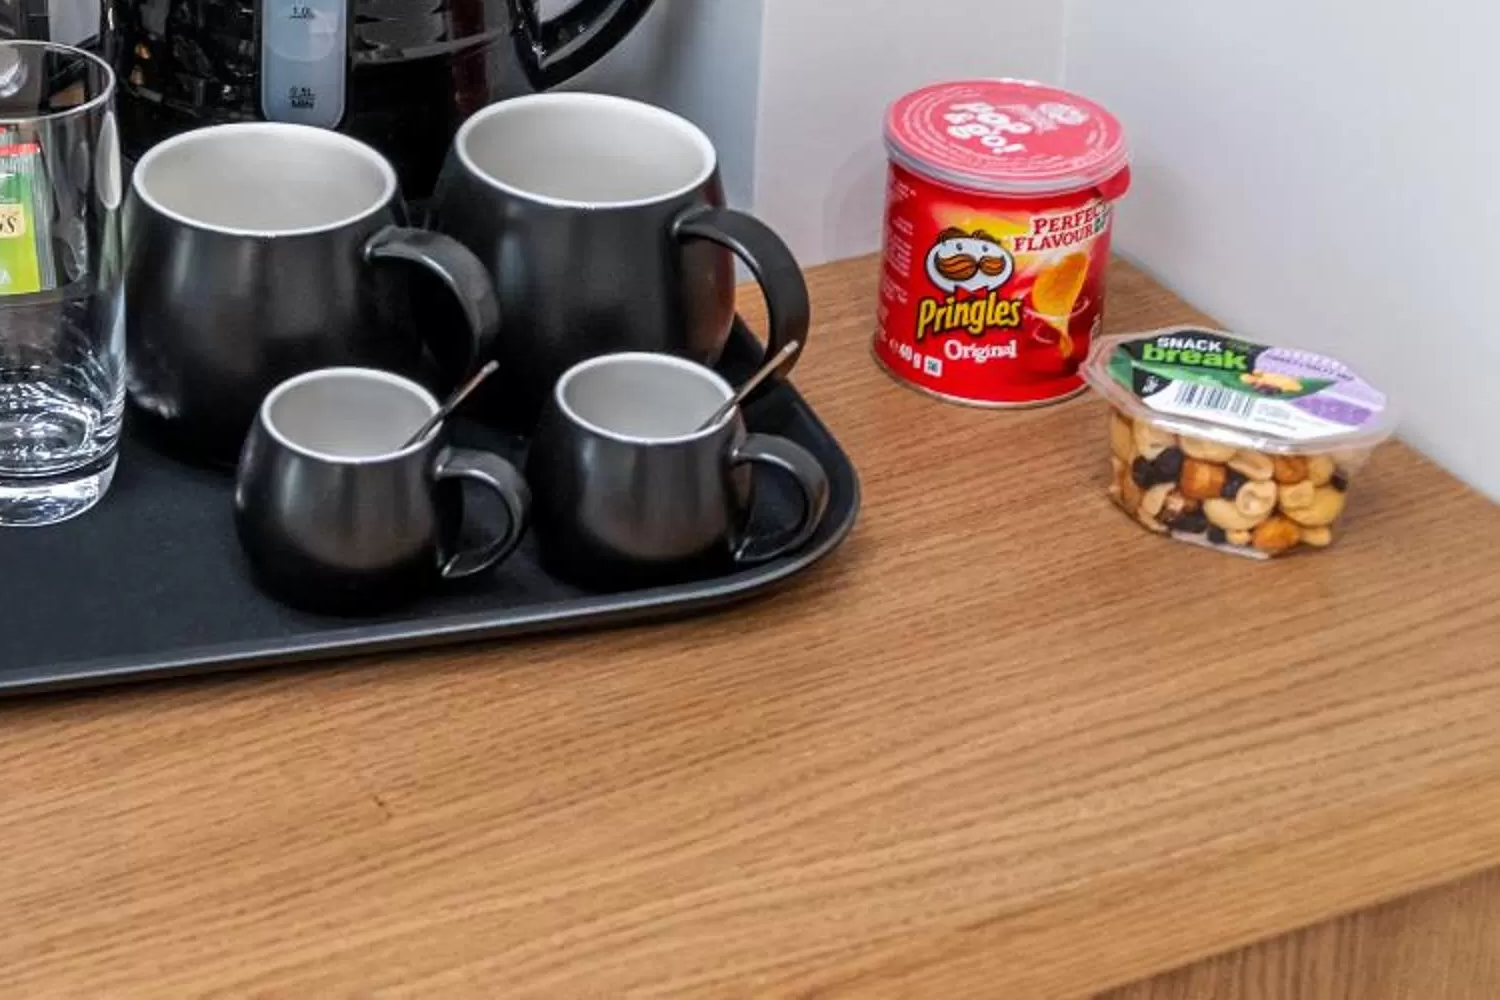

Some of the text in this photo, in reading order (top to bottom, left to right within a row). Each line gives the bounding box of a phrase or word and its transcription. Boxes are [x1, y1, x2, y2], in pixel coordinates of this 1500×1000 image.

[1012, 223, 1094, 253] FLAVOUR
[916, 291, 1022, 340] Pringles
[944, 339, 1018, 364] Original
[1142, 343, 1248, 370] break
[1156, 337, 1223, 352] SNACK
